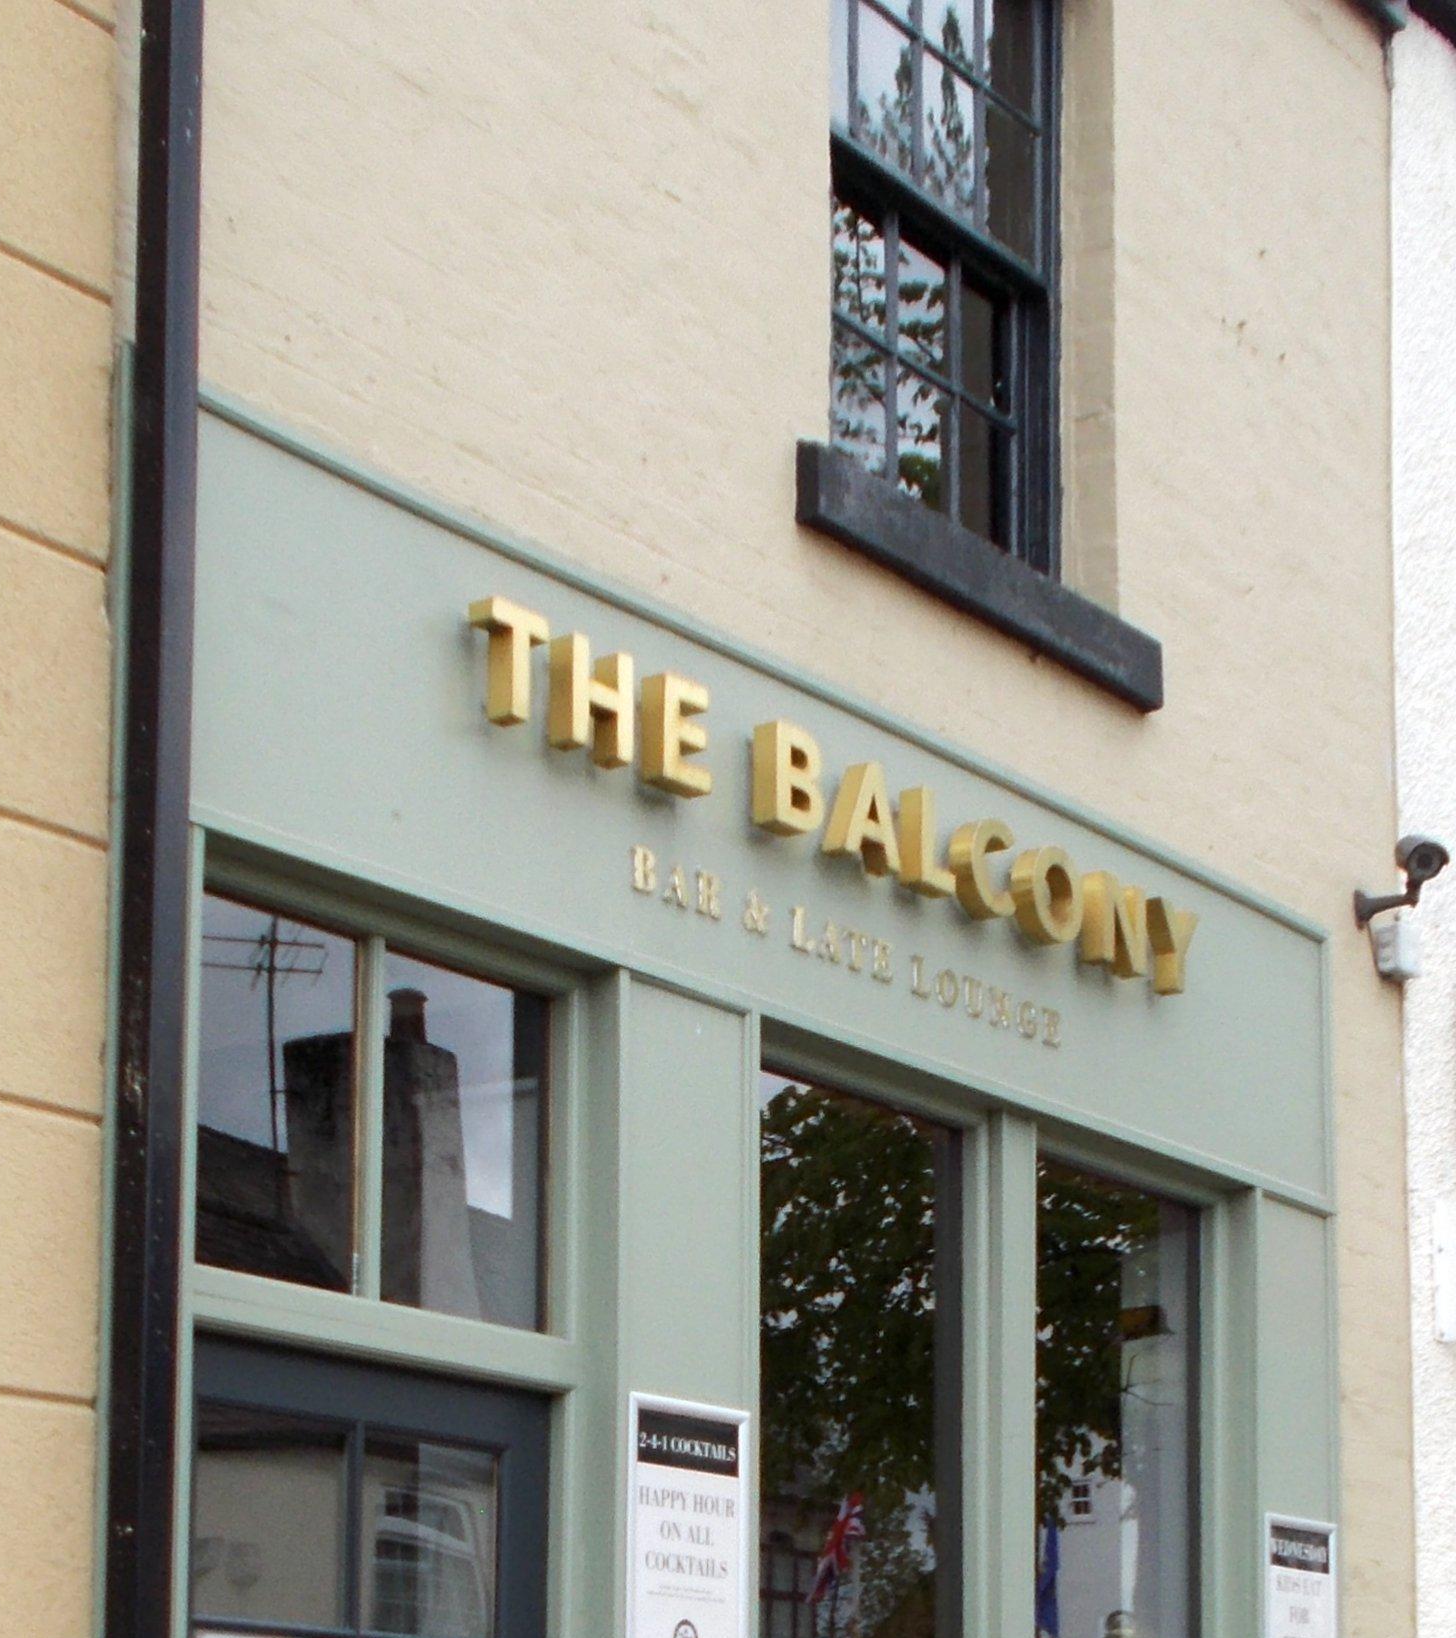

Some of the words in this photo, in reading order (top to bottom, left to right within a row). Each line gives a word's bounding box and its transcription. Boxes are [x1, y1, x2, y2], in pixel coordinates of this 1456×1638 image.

[469, 596, 712, 798] THE
[751, 719, 1199, 996] BALCONY
[631, 844, 721, 921] BAR
[744, 889, 770, 934] &
[790, 905, 894, 984] LATE
[910, 954, 1061, 1048] LOUNGE
[639, 1431, 667, 1451] 2-4-1
[670, 1436, 736, 1462] COCKTAILS
[638, 1485, 686, 1511] HAPPY
[693, 1493, 735, 1518] HOUR
[660, 1520, 681, 1541] ON
[688, 1524, 715, 1546] ALL
[645, 1550, 728, 1579] COCKTAILS
